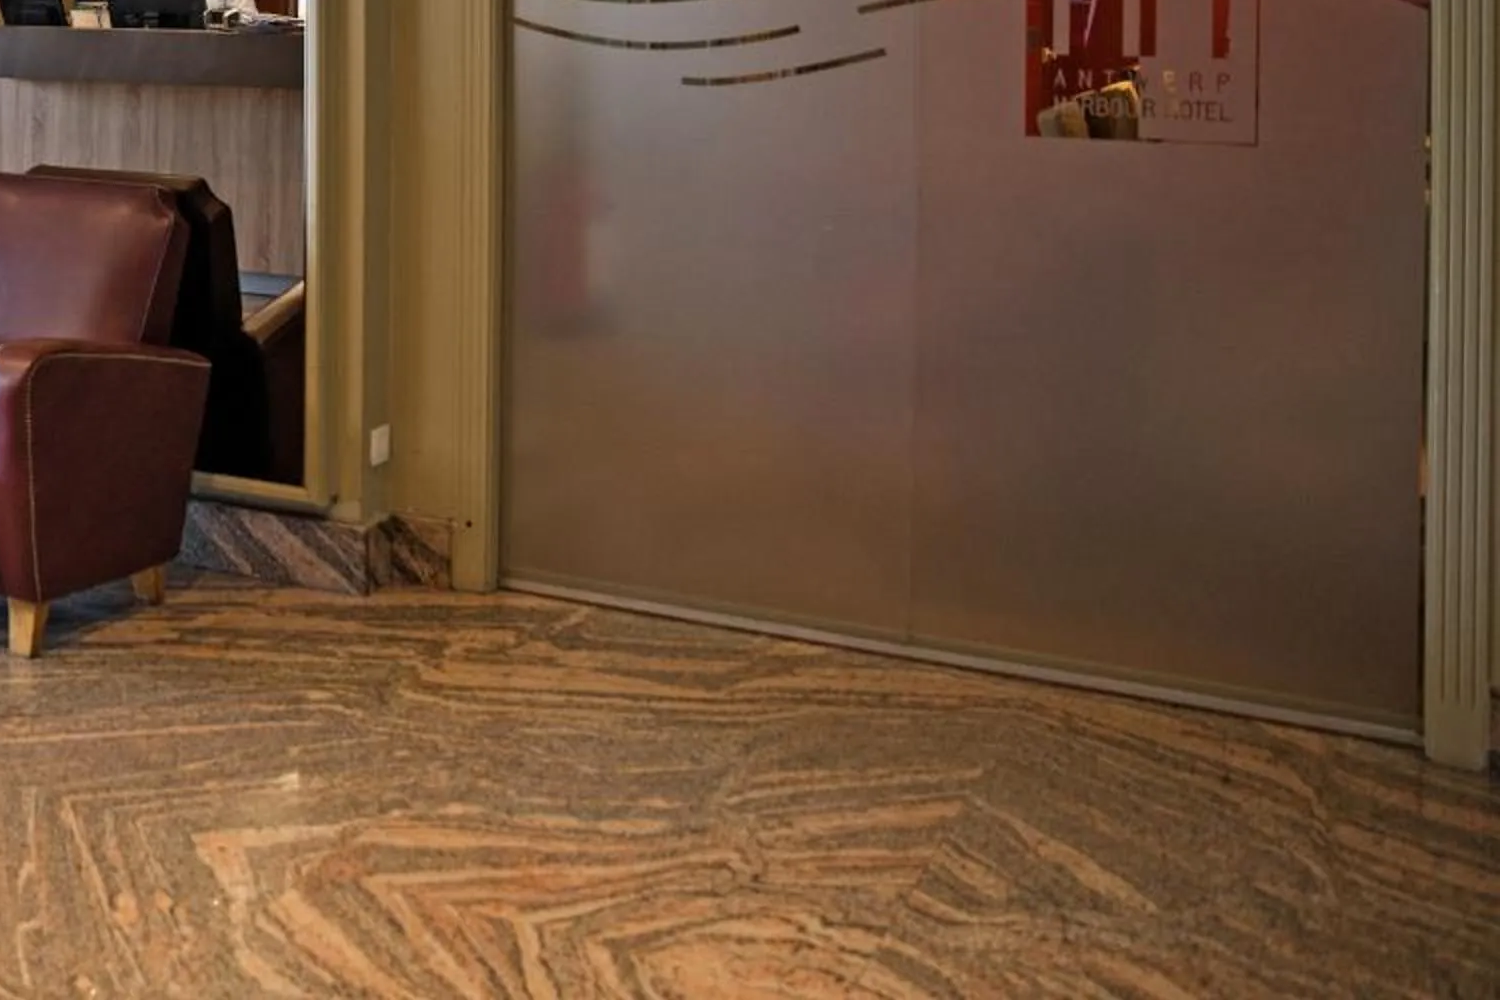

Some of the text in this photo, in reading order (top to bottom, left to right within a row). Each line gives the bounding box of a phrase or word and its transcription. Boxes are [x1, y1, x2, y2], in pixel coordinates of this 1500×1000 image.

[1053, 68, 1232, 93] ANTWERP
[1053, 96, 1233, 123] RBOUR OTEL
